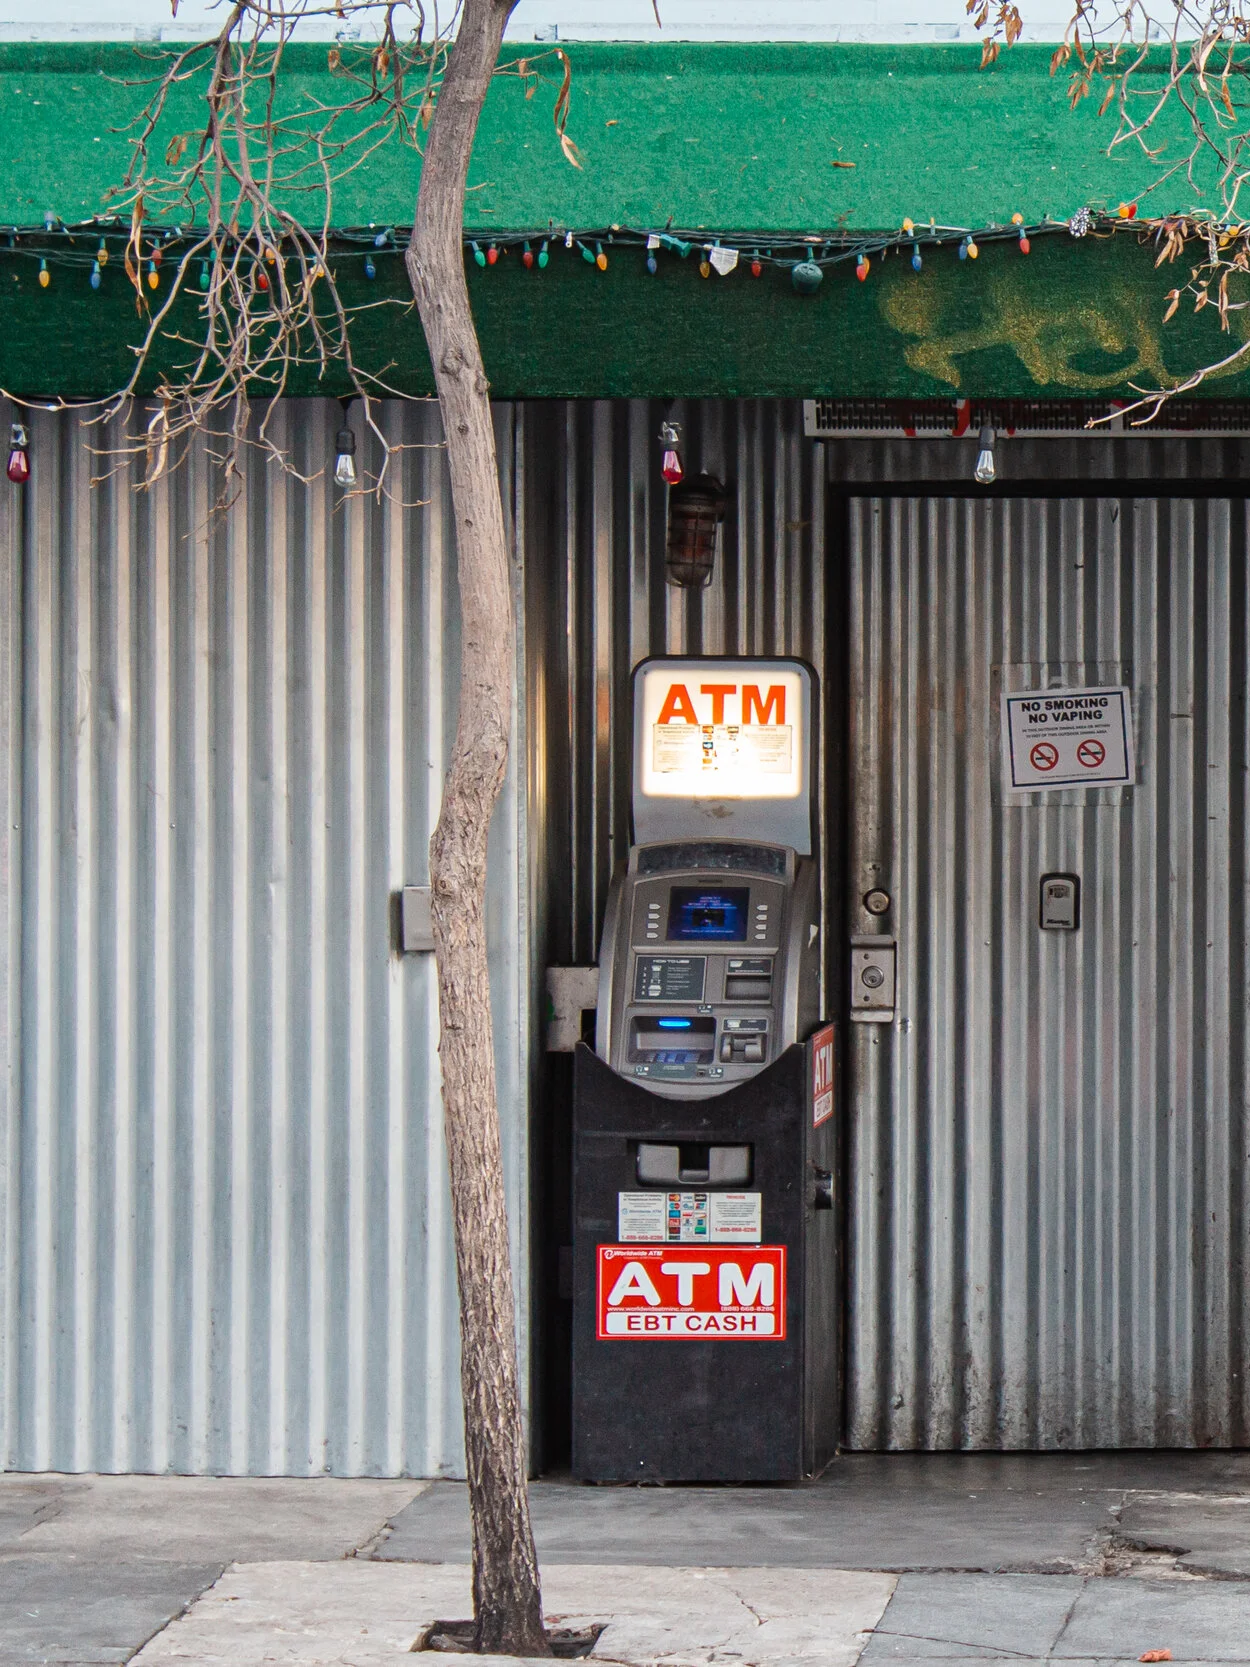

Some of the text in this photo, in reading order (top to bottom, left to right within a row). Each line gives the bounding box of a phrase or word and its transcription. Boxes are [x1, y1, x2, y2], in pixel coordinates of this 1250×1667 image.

[657, 684, 786, 725] ATM
[1021, 697, 1109, 712] NO SMOKING
[1028, 710, 1103, 724] NO VAPING
[814, 1042, 833, 1095] ATM
[607, 1261, 775, 1307] ATM
[627, 1315, 757, 1332] EBT CASH
